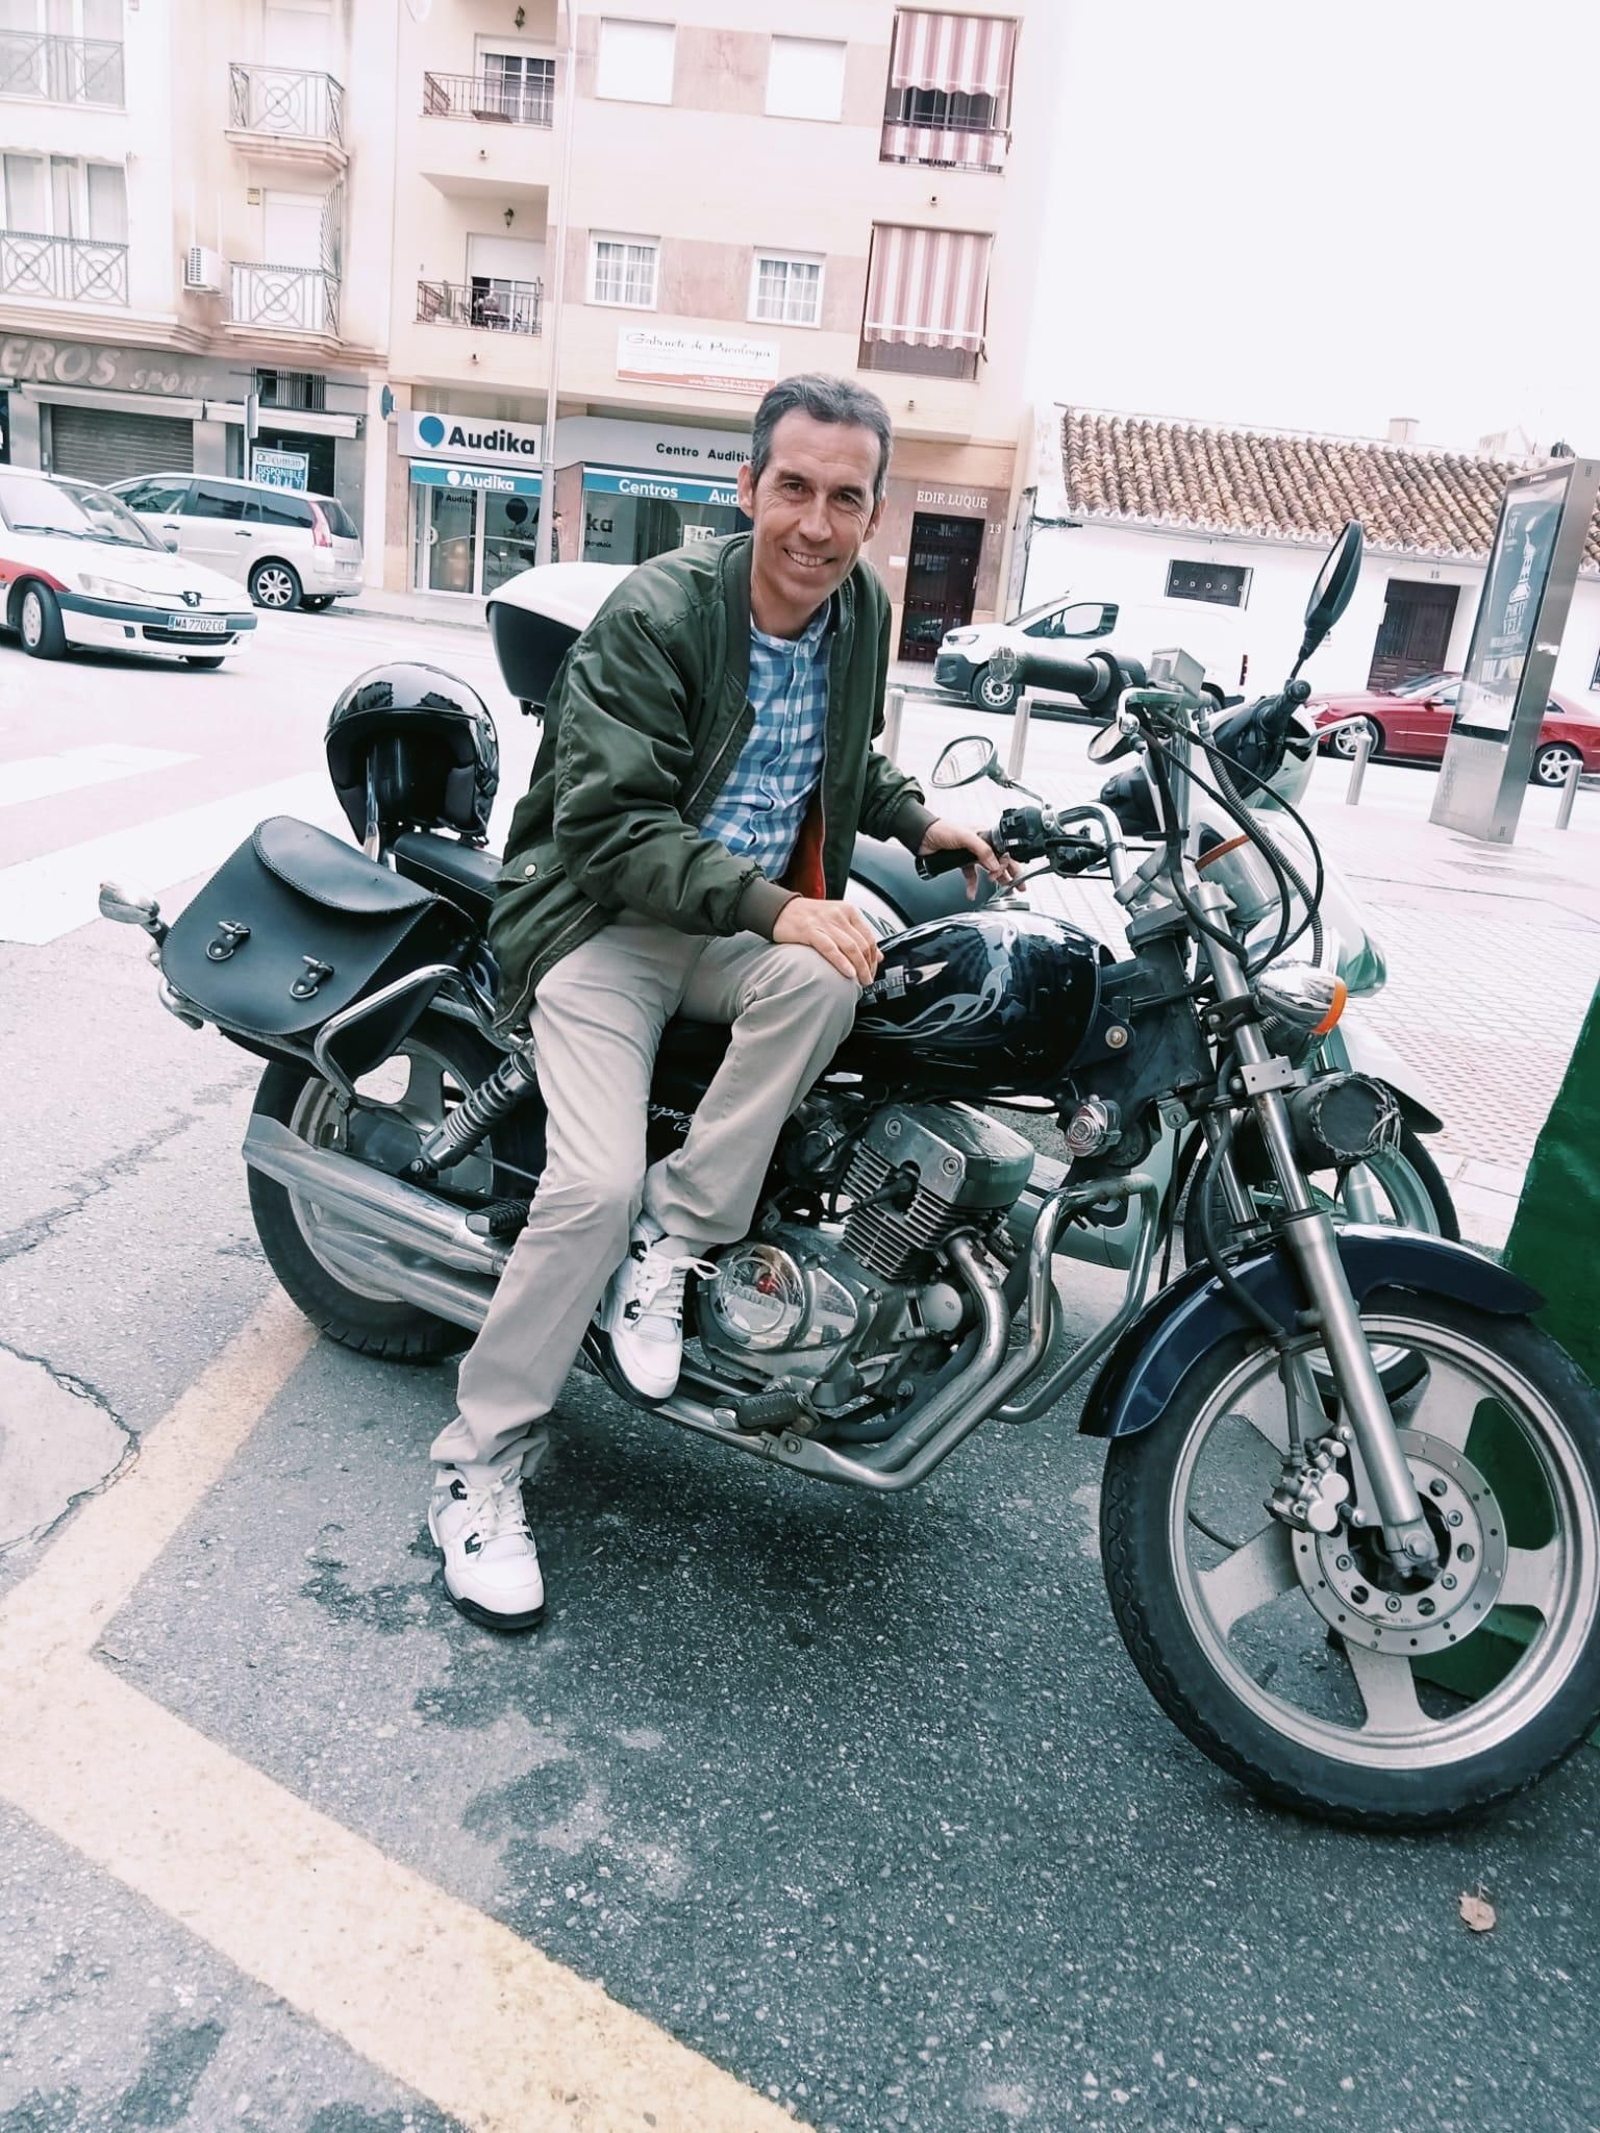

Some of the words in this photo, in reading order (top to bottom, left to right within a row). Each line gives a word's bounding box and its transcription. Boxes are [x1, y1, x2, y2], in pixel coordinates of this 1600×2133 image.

[692, 340, 702, 350] de
[130, 368, 213, 395] SPORT
[448, 426, 535, 454] Audika
[656, 443, 699, 457] Centro
[257, 465, 305, 479] DISPONIBLE
[462, 473, 515, 491] Audika
[619, 479, 678, 499] Centros
[948, 493, 989, 509] LUQUE
[989, 523, 1002, 534] 13
[175, 618, 188, 630] MA
[188, 619, 212, 631] 7702
